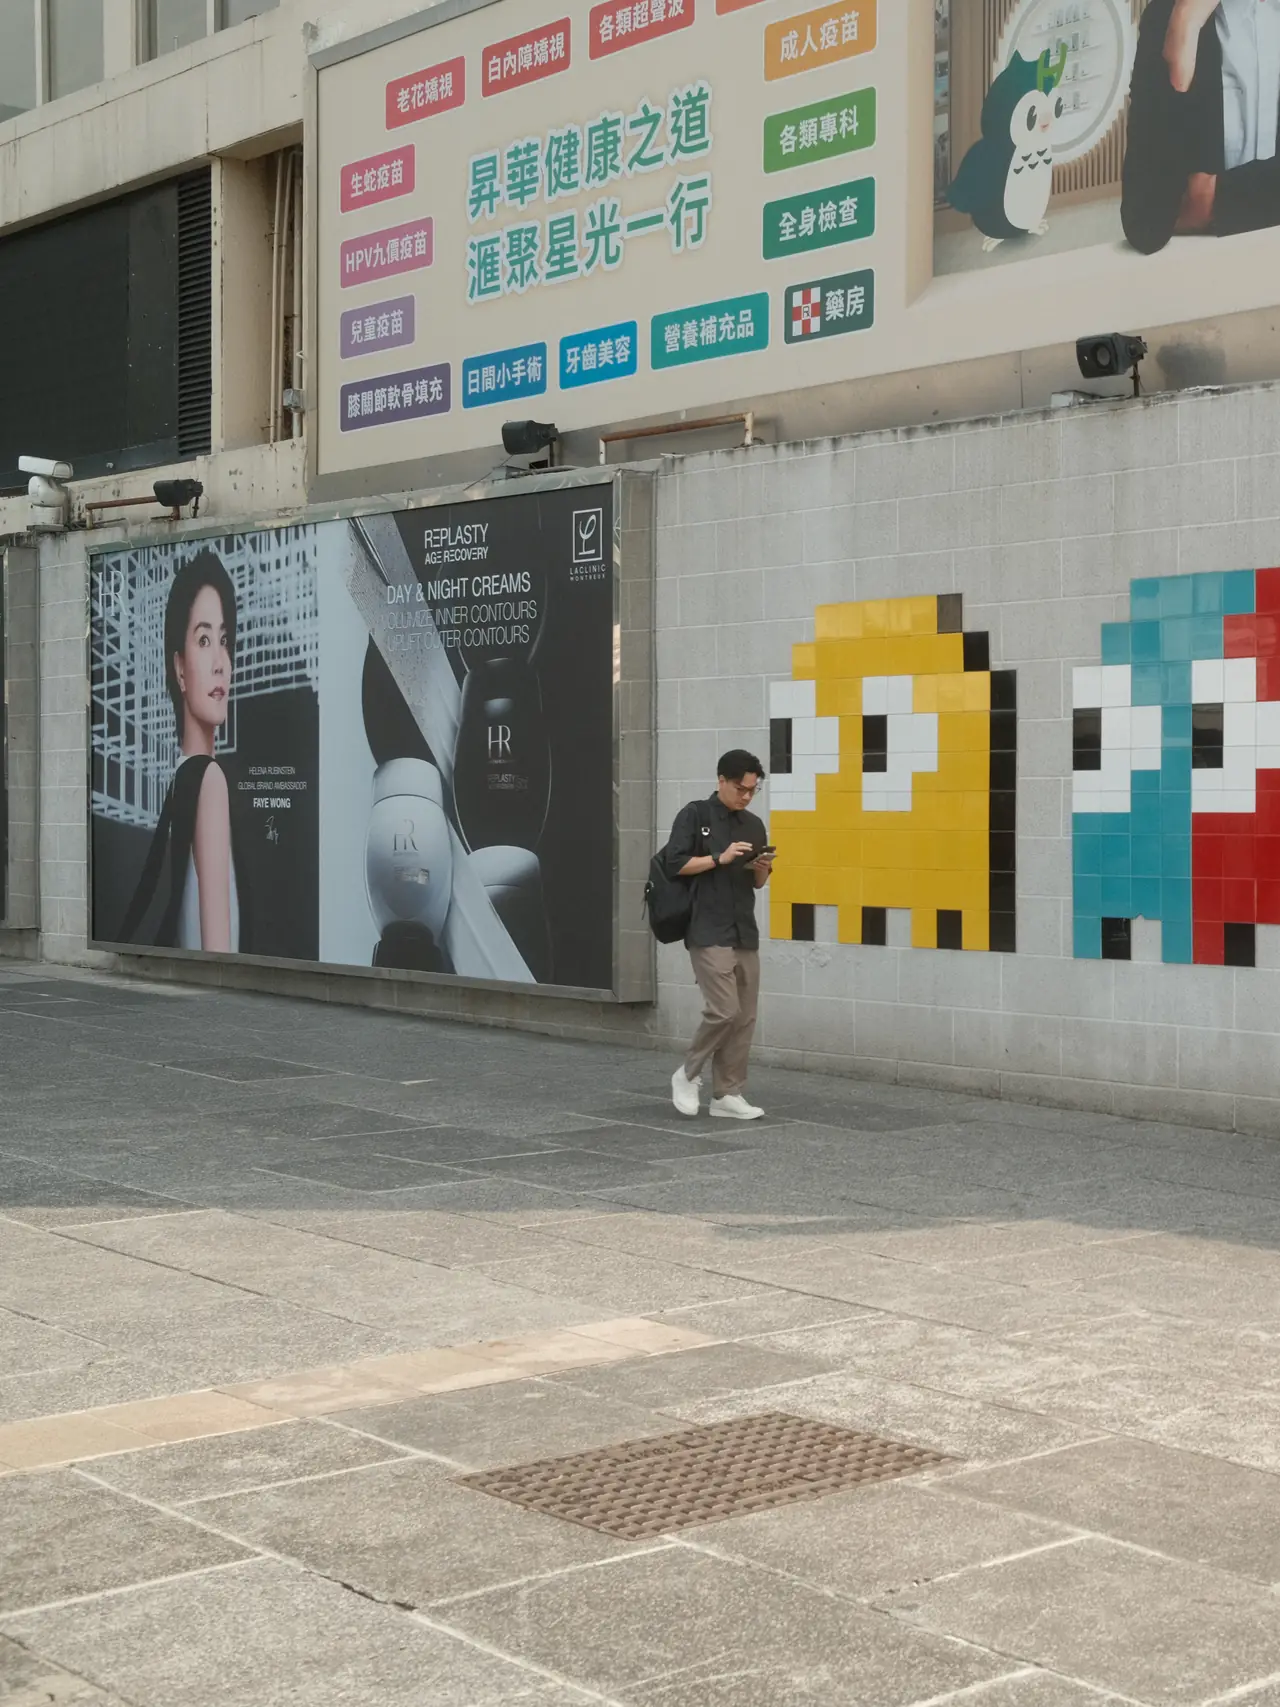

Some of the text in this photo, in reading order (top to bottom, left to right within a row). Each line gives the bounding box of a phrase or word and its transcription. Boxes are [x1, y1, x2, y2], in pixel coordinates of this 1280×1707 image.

[599, 0, 684, 43] 各類超聲波
[780, 10, 859, 62] 成人疫苗
[488, 33, 565, 84] 白內障矯視
[397, 72, 453, 113] 老花矯視
[780, 105, 859, 155] 各類專科
[468, 86, 710, 218] 昇華健康之道
[350, 159, 404, 198] 生蛇疫苗
[779, 196, 858, 242] 全身檢查
[346, 230, 427, 274] HPV九價疫苗
[825, 285, 865, 321] 藥房
[350, 309, 404, 344] 兒童疫苗
[664, 309, 754, 354] 營養補充品
[565, 335, 630, 374] 牙齒美容
[467, 355, 542, 395] 日間小手術
[348, 376, 443, 419] 膝關節軟骨填充
[425, 523, 489, 549] REPLASTY
[425, 546, 489, 565] AGE RECOVERY
[387, 571, 531, 604] DAY & NIGHT CREAMS
[569, 564, 606, 575] LACLINIC
[386, 600, 537, 629] OLUMIZE INNER CONTOURS
[464, 625, 530, 647] CONTOURS
[487, 725, 512, 758] HR
[253, 797, 291, 809] FAYE WONG
